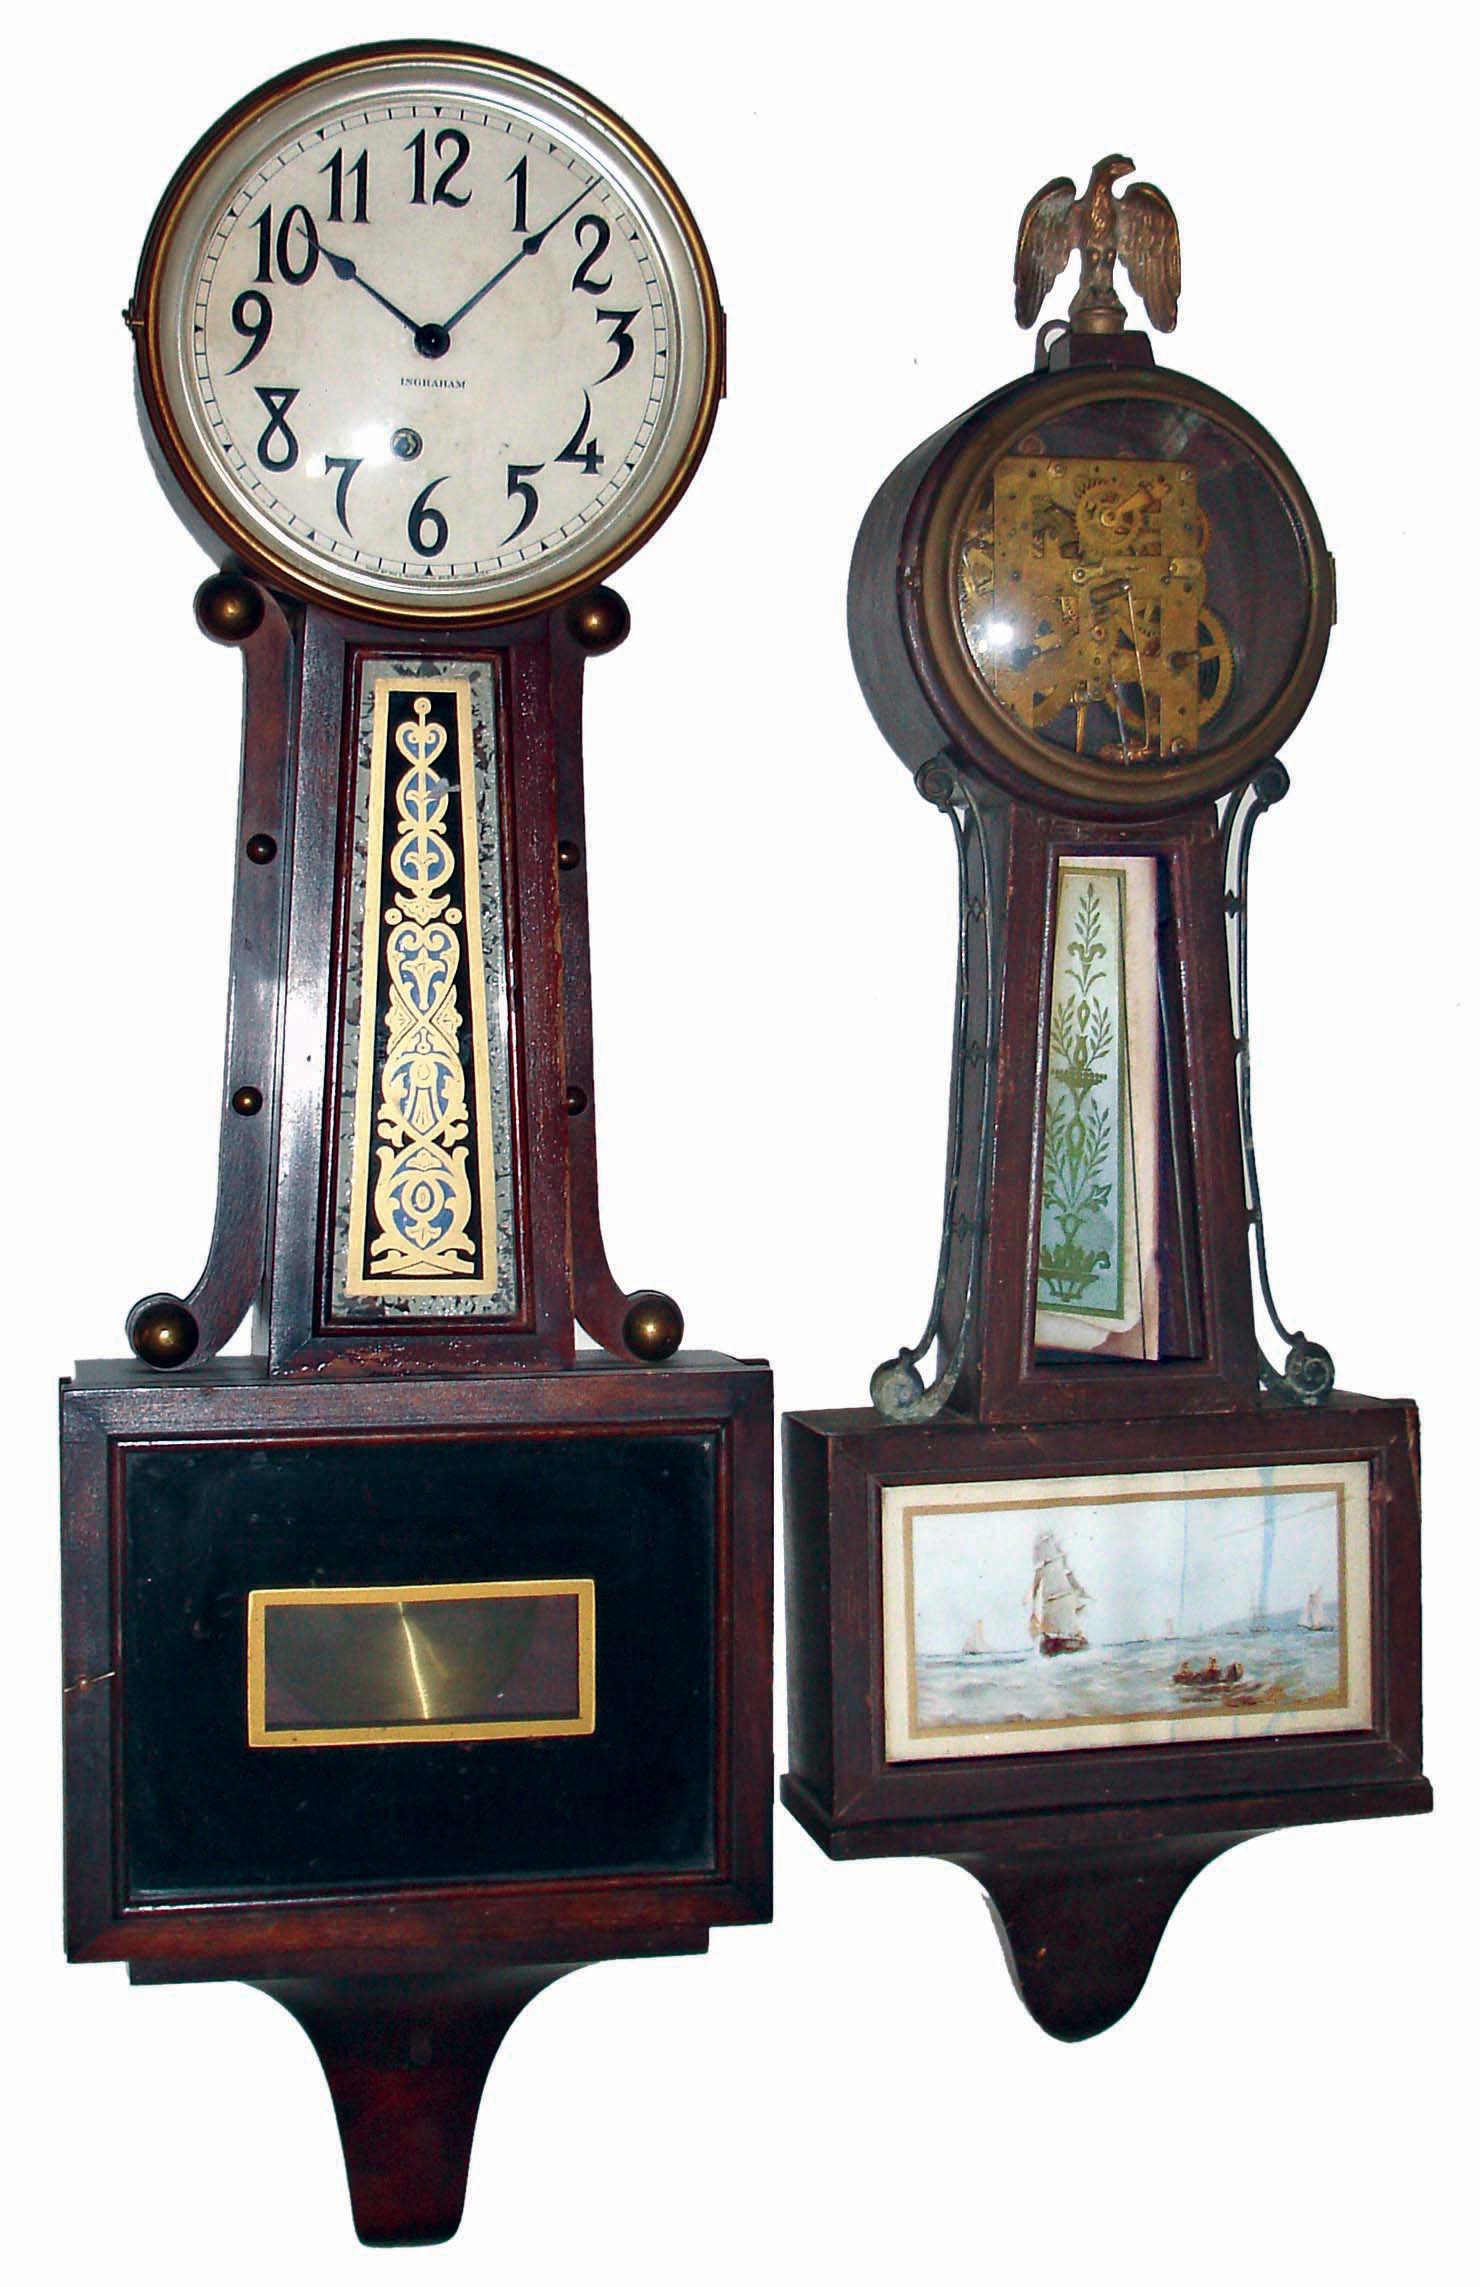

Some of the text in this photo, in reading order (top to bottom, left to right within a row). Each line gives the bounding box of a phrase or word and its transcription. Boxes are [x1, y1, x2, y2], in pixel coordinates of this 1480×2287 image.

[318, 147, 371, 223] 11
[403, 127, 472, 208] 12
[505, 155, 530, 232] 1
[248, 204, 319, 286] 10
[572, 213, 613, 295] 2
[224, 290, 273, 376] 9
[593, 307, 642, 386] 3
[400, 377, 466, 389] INGRAHAM
[253, 386, 301, 473] 8
[553, 389, 605, 475] 4
[323, 455, 364, 538] 7
[407, 475, 450, 557] 6
[500, 463, 546, 547] 5
